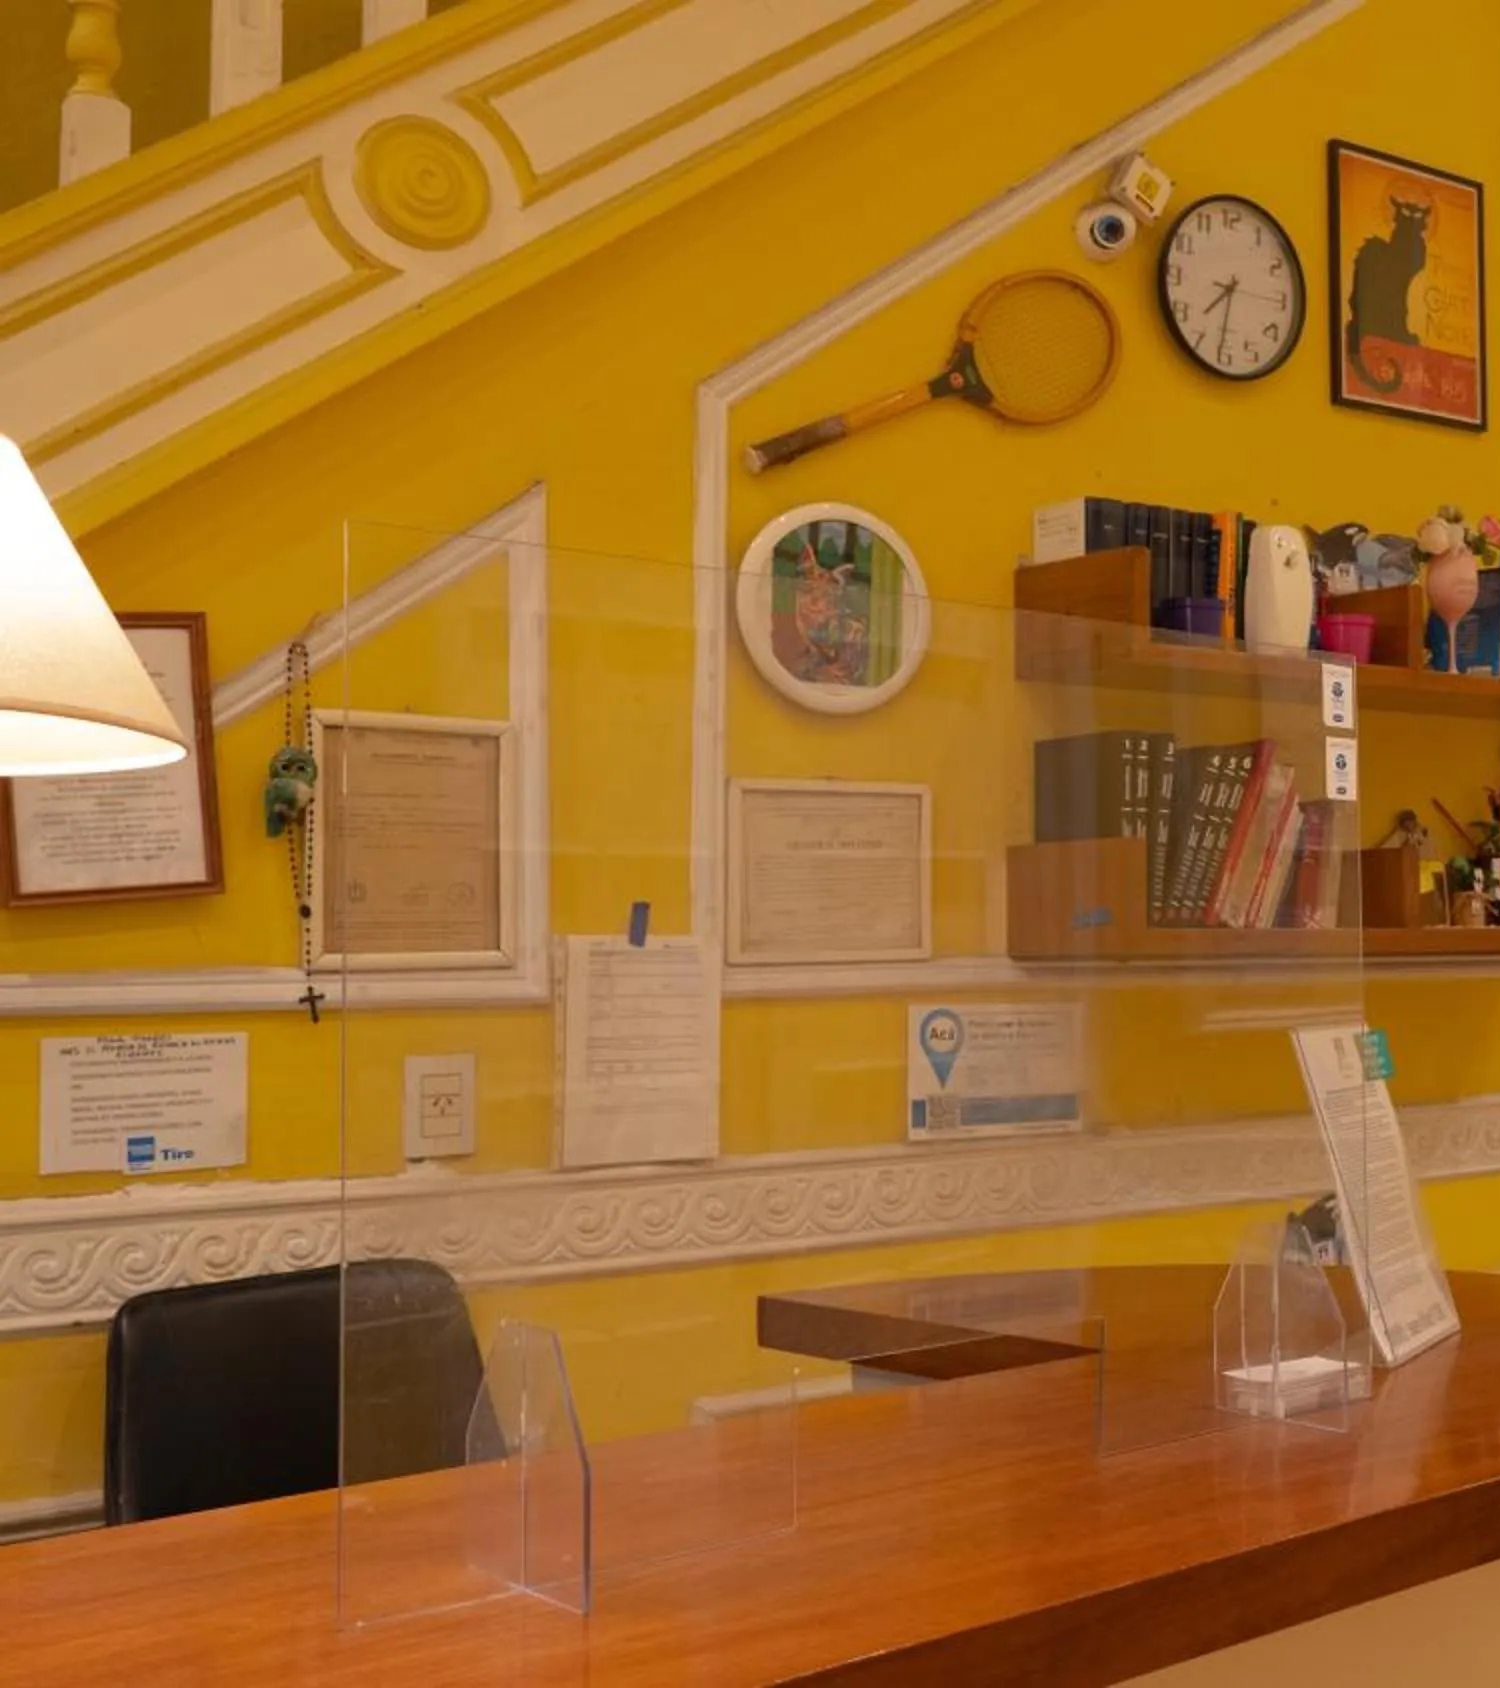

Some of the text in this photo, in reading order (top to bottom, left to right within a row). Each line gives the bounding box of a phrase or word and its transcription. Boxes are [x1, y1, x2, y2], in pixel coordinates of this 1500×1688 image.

[1197, 212, 1211, 234] 11
[1222, 208, 1241, 230] 12
[1169, 263, 1182, 286] 9
[1270, 258, 1283, 277] 2
[1173, 301, 1188, 322] 8
[1191, 330, 1206, 349] 7
[1262, 321, 1279, 342] 4
[1216, 343, 1232, 366] 6
[1244, 340, 1259, 363] 5
